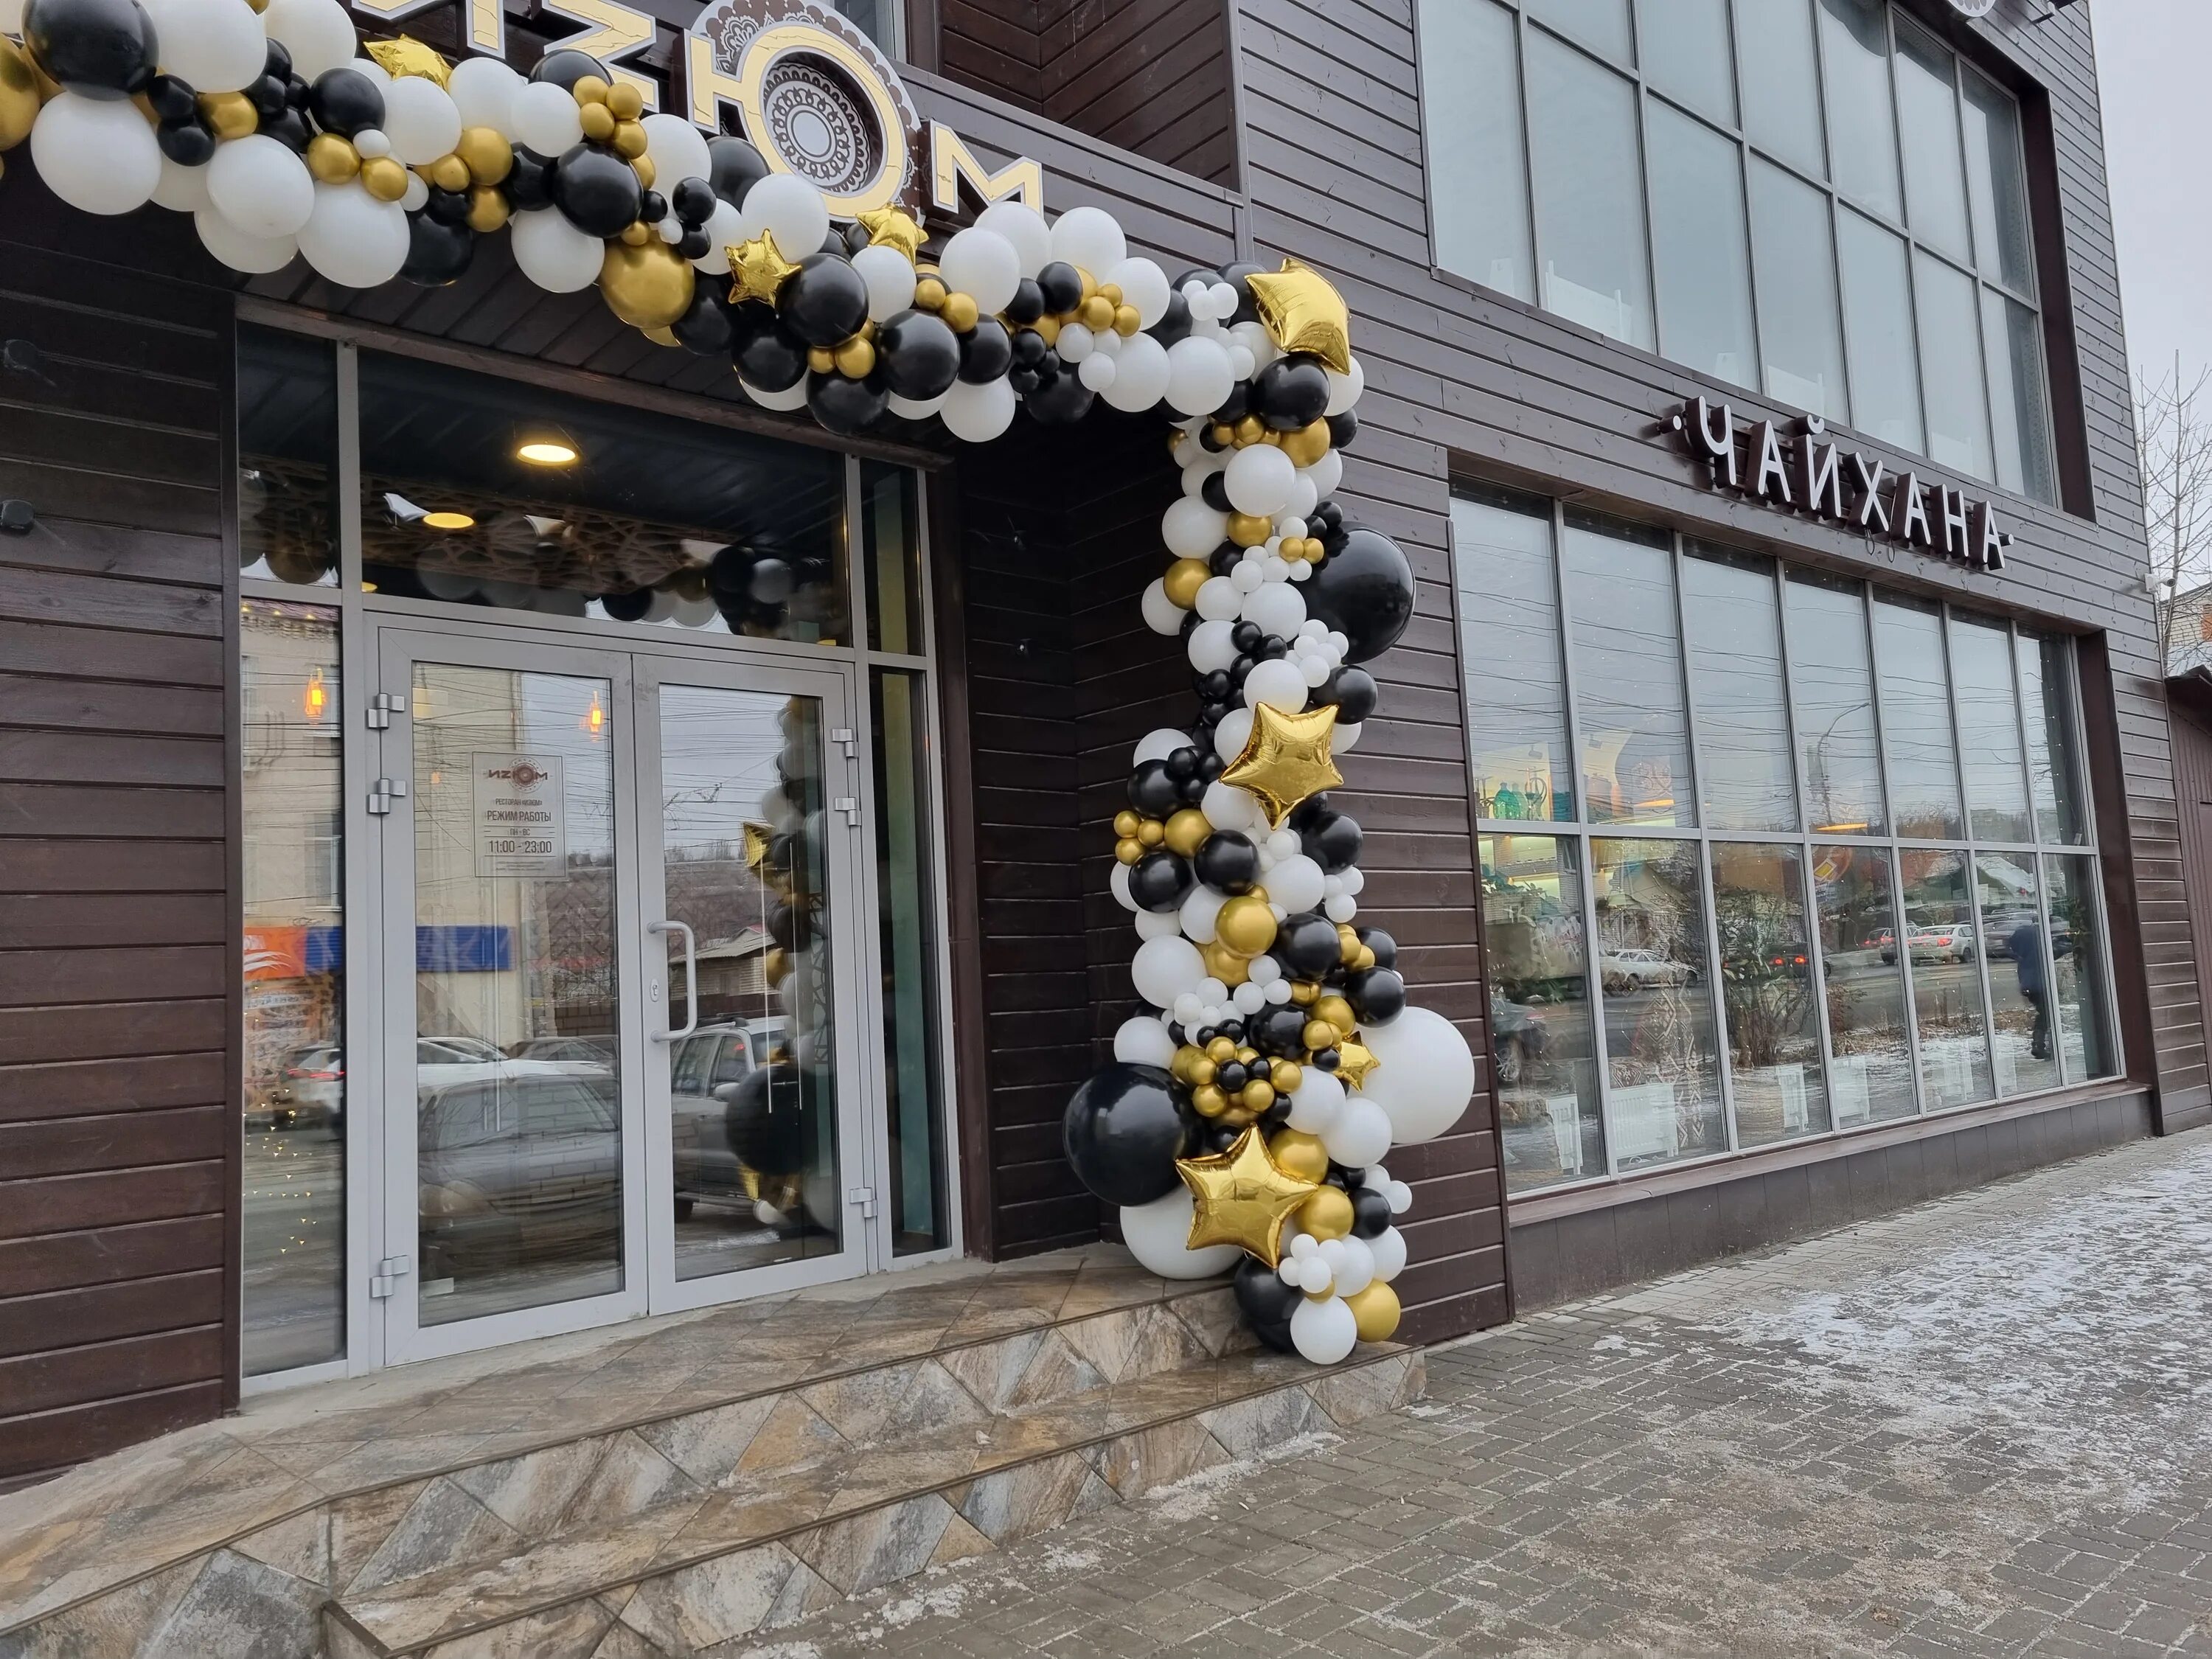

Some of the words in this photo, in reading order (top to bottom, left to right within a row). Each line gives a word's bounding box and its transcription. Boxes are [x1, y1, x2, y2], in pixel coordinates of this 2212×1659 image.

[1697, 395, 2006, 569] ЧАЙХАНА
[487, 810, 517, 821] РЕЖИМ
[519, 811, 552, 822] РАБОТЫ
[522, 828, 531, 836] ВС
[489, 840, 515, 853] 11:00
[524, 841, 552, 854] 23:00
